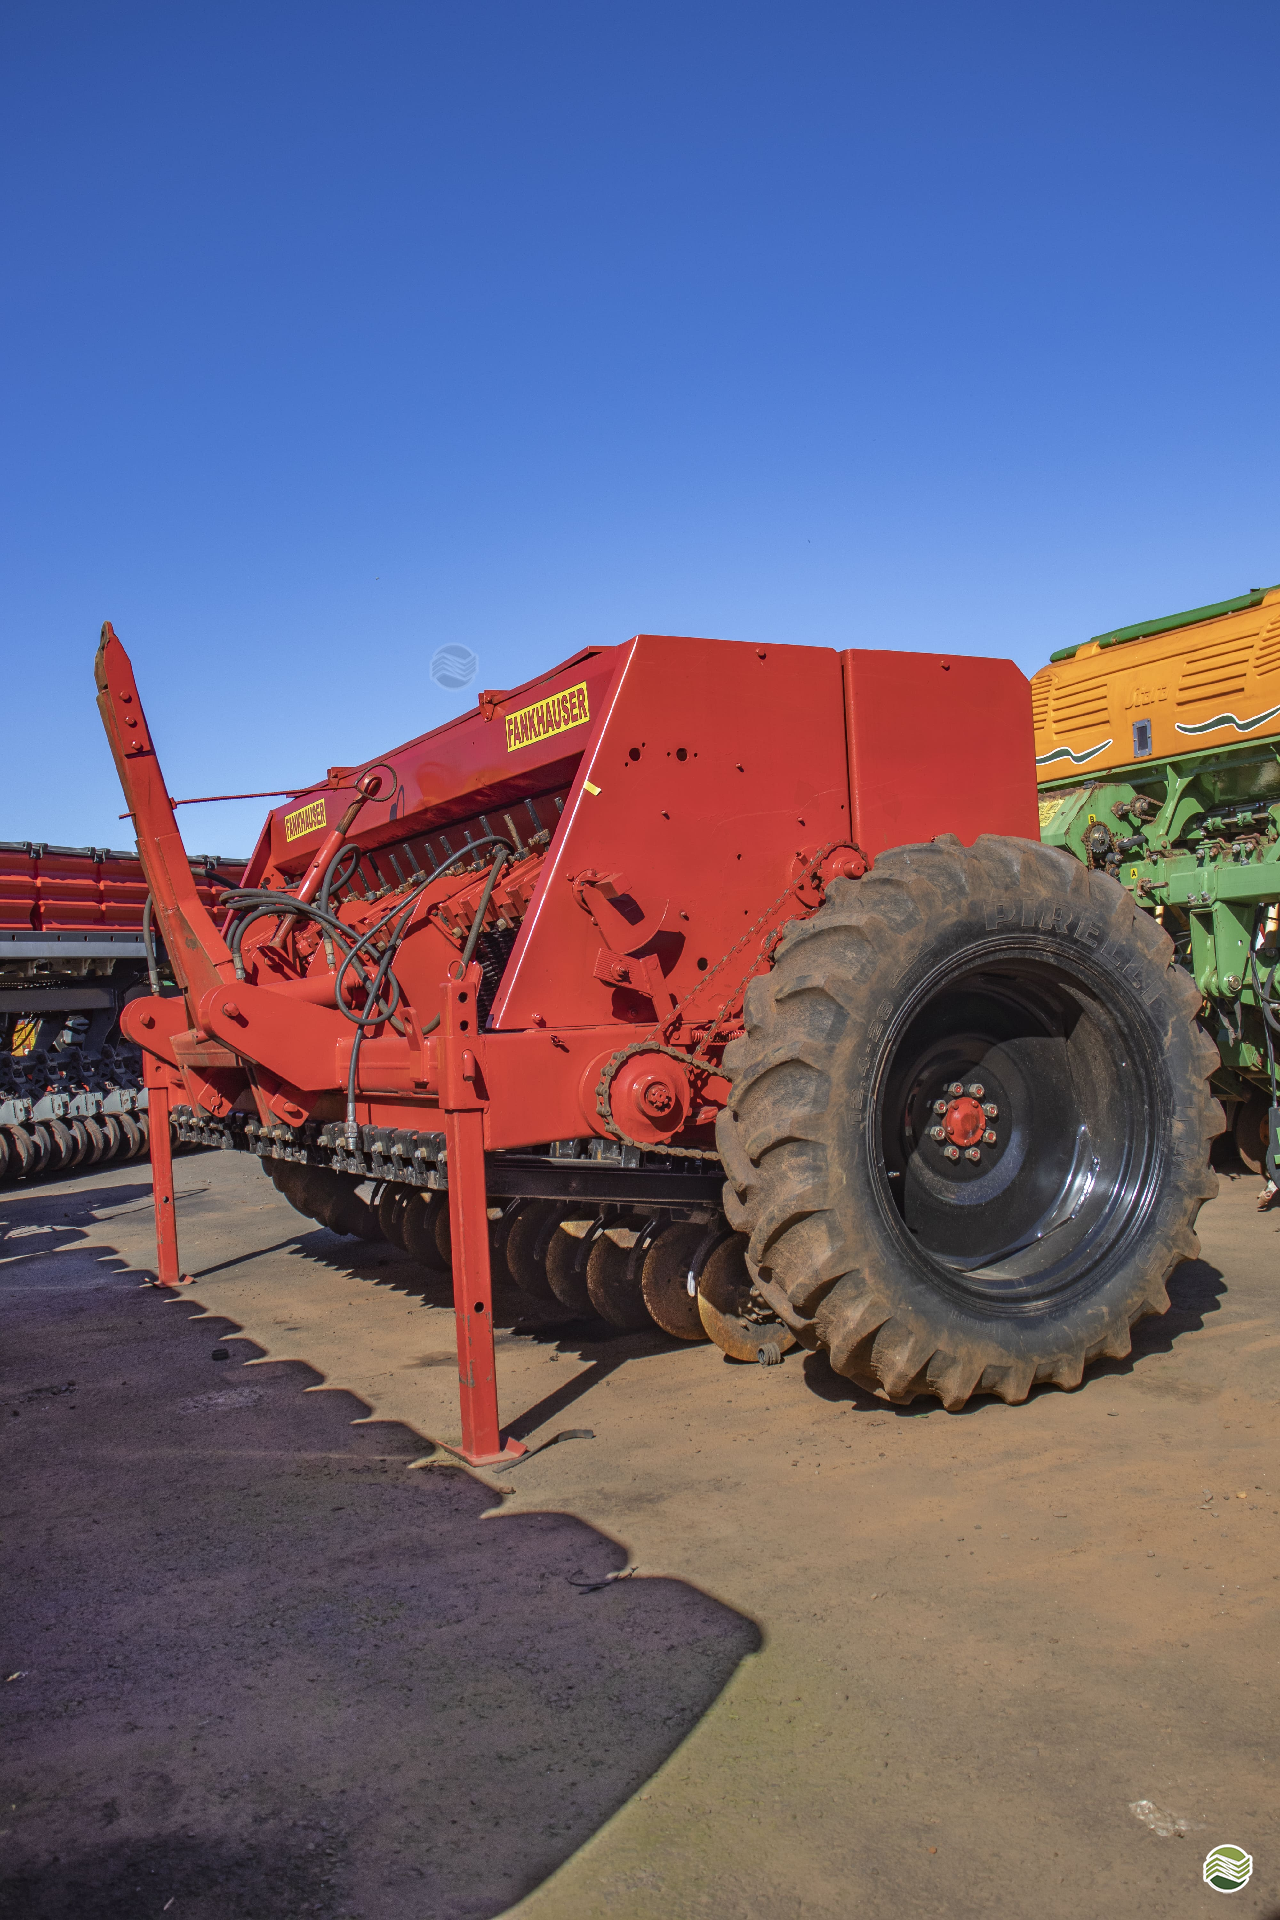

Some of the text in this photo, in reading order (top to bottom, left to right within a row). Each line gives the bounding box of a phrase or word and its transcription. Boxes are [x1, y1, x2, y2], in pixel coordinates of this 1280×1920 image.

[506, 687, 588, 749] FANKHAUSER
[285, 801, 326, 840] FANKHAUSER
[983, 897, 1164, 1006] PIRELLI
